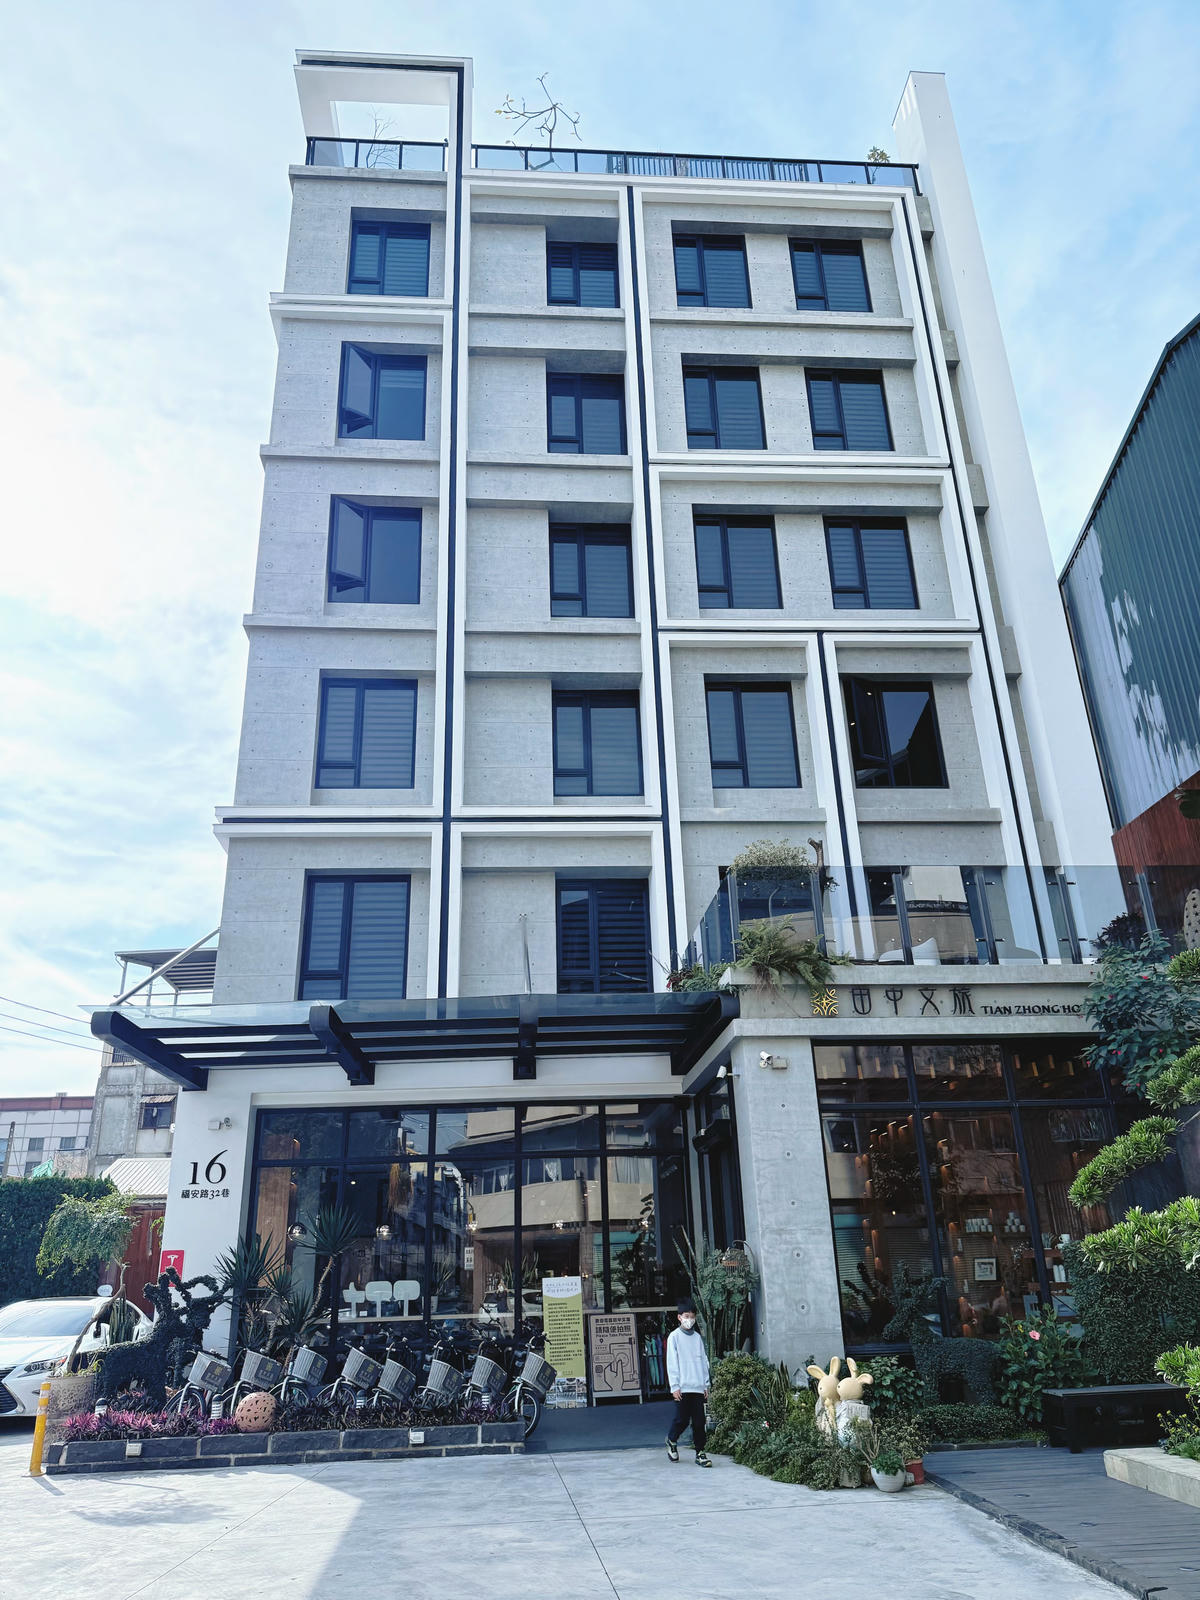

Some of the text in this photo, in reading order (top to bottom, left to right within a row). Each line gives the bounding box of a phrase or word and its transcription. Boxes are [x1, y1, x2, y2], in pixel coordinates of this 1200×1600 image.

[980, 1005, 1012, 1015] TIAN
[1014, 1004, 1060, 1014] ZHONG
[188, 1149, 228, 1185] 16
